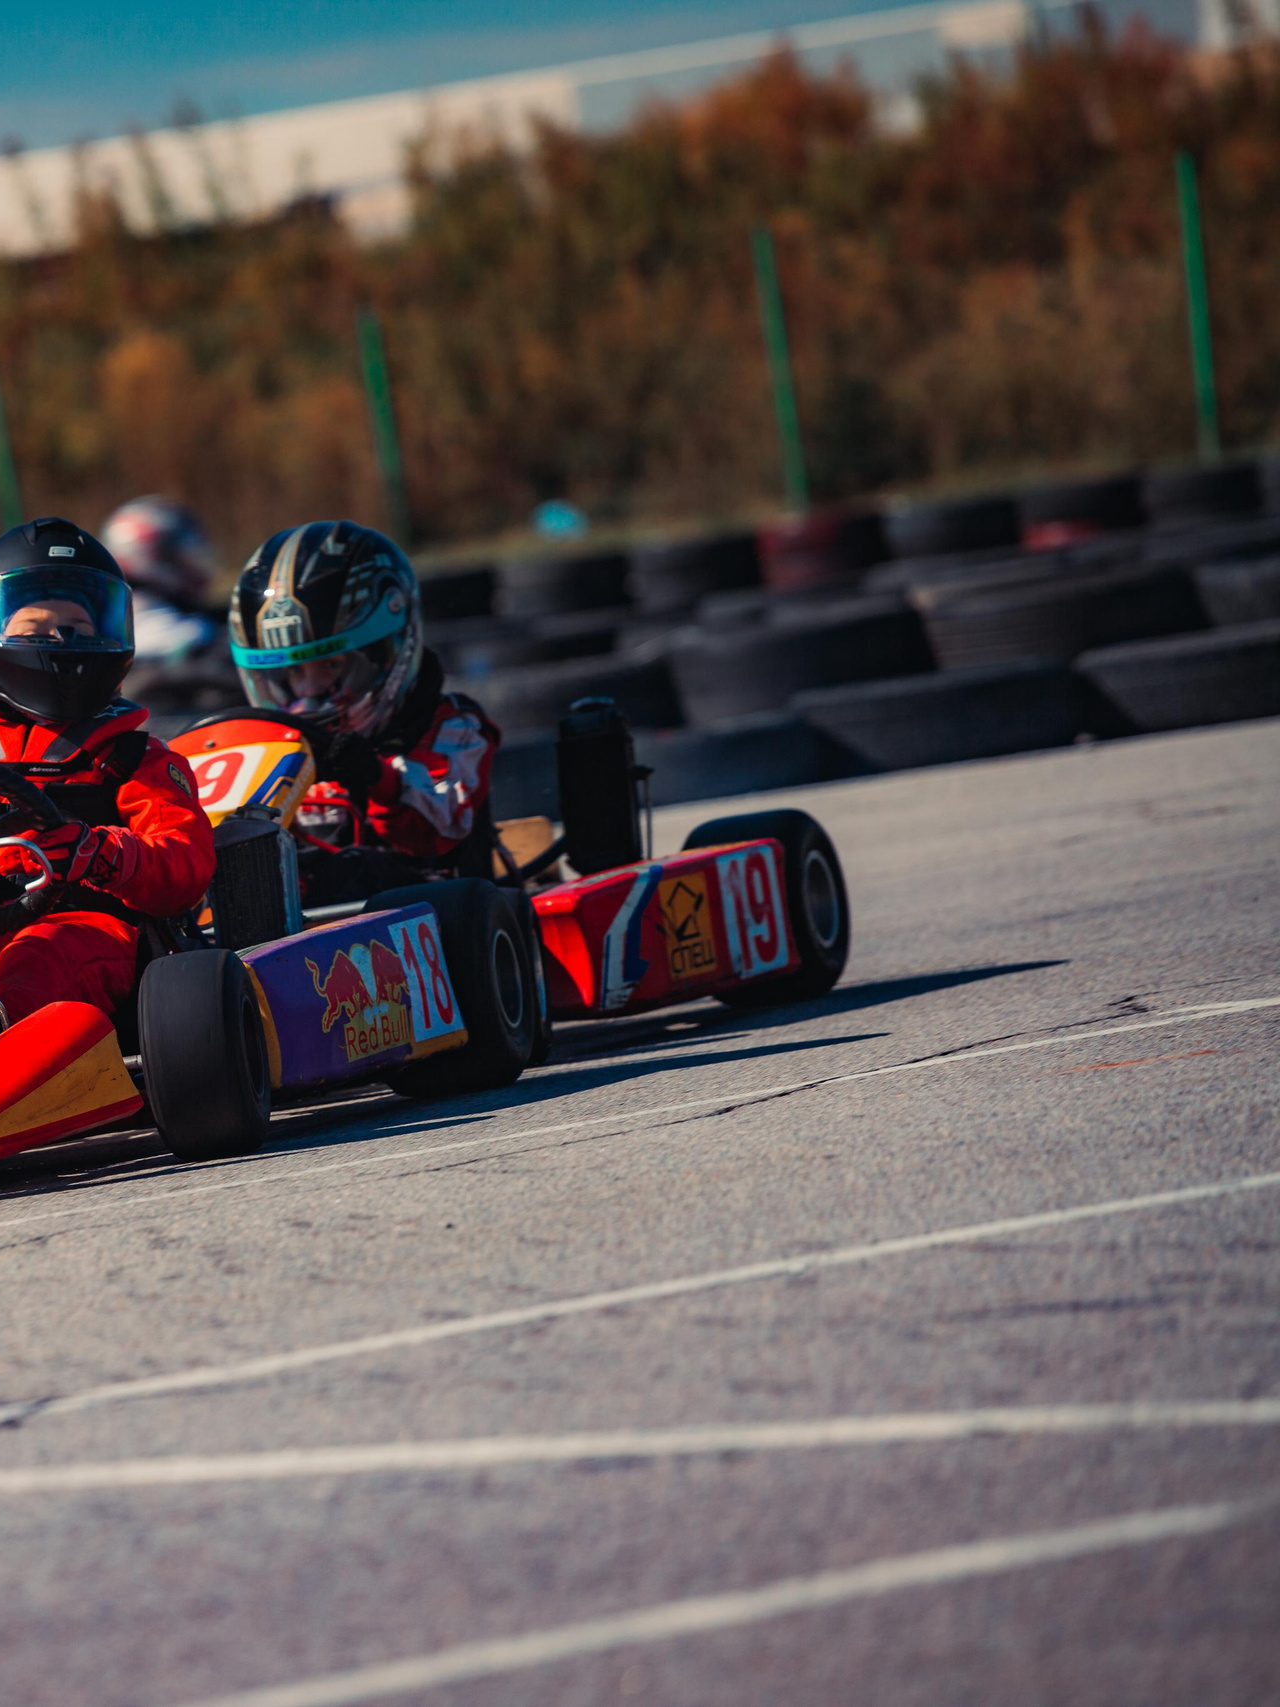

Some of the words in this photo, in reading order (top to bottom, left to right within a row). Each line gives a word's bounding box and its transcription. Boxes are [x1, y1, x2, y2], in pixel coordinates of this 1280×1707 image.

[195, 752, 245, 807] 9
[727, 851, 779, 971] 19
[401, 922, 454, 1029] 18
[346, 1017, 380, 1058] Red
[381, 1009, 409, 1047] Bull
